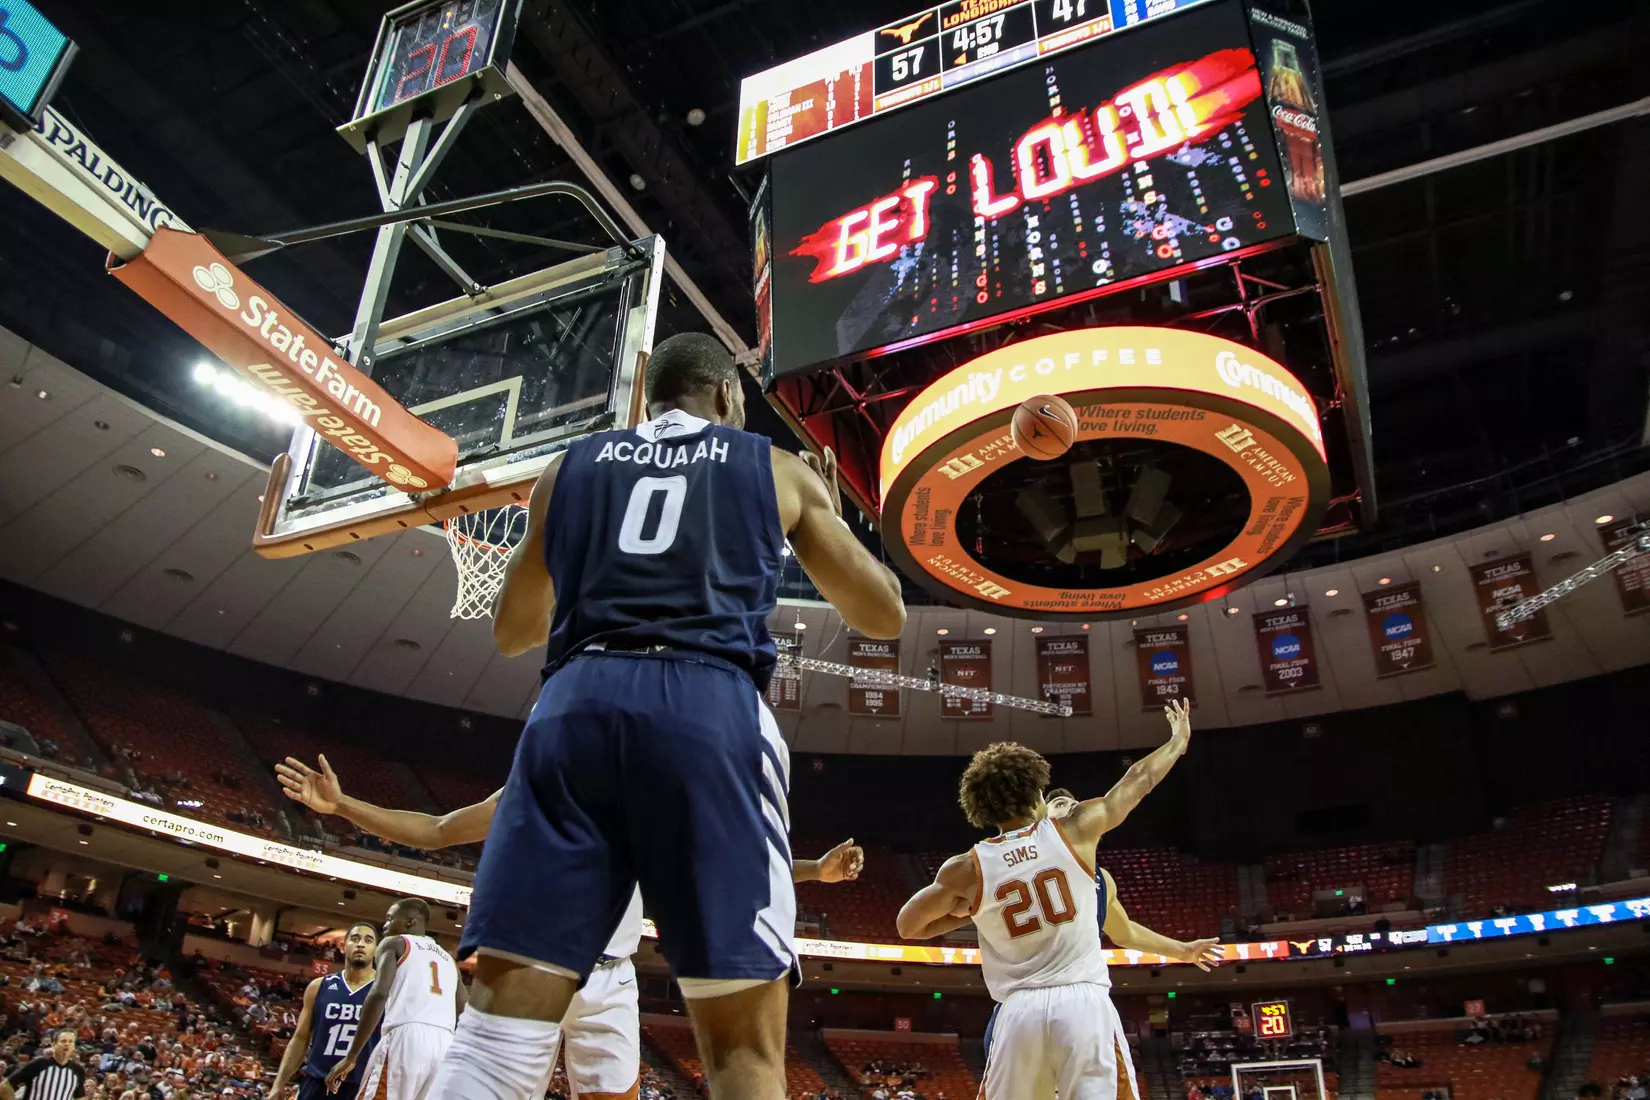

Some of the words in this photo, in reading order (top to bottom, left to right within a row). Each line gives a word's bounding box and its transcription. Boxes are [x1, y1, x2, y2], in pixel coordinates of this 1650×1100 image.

[1052, 0, 1086, 22] 47
[953, 13, 1005, 52] 4:57
[394, 25, 478, 103] 20
[892, 46, 925, 81] 57
[1272, 105, 1316, 132] Coca-Cola
[830, 181, 936, 275] GET
[240, 295, 382, 428] StateFarm
[1009, 348, 1162, 383] COFFEE
[1079, 405, 1131, 419] Where
[1135, 407, 1206, 422] students
[595, 436, 730, 469] ACQUAAH
[1251, 444, 1296, 483] AMERICAN
[1240, 451, 1285, 488] CAMPUS
[618, 474, 688, 555] 0
[1484, 561, 1521, 579] TEXAS
[1374, 592, 1410, 607] TEXAS
[1265, 614, 1298, 627] TEXAS
[859, 644, 889, 652] TEXAS
[950, 646, 981, 655] TEXAS
[1046, 642, 1078, 651] TEXAS
[1145, 632, 1178, 643] TEXAS
[1278, 667, 1304, 680] 2003
[142, 814, 224, 843] certapro.com
[1003, 845, 1038, 868] SIMS
[993, 866, 1078, 940] 20
[314, 964, 329, 974] 33
[429, 960, 443, 997] 1
[896, 1019, 909, 1029] 30
[1261, 1015, 1285, 1035] 20
[323, 1023, 358, 1057] 15
